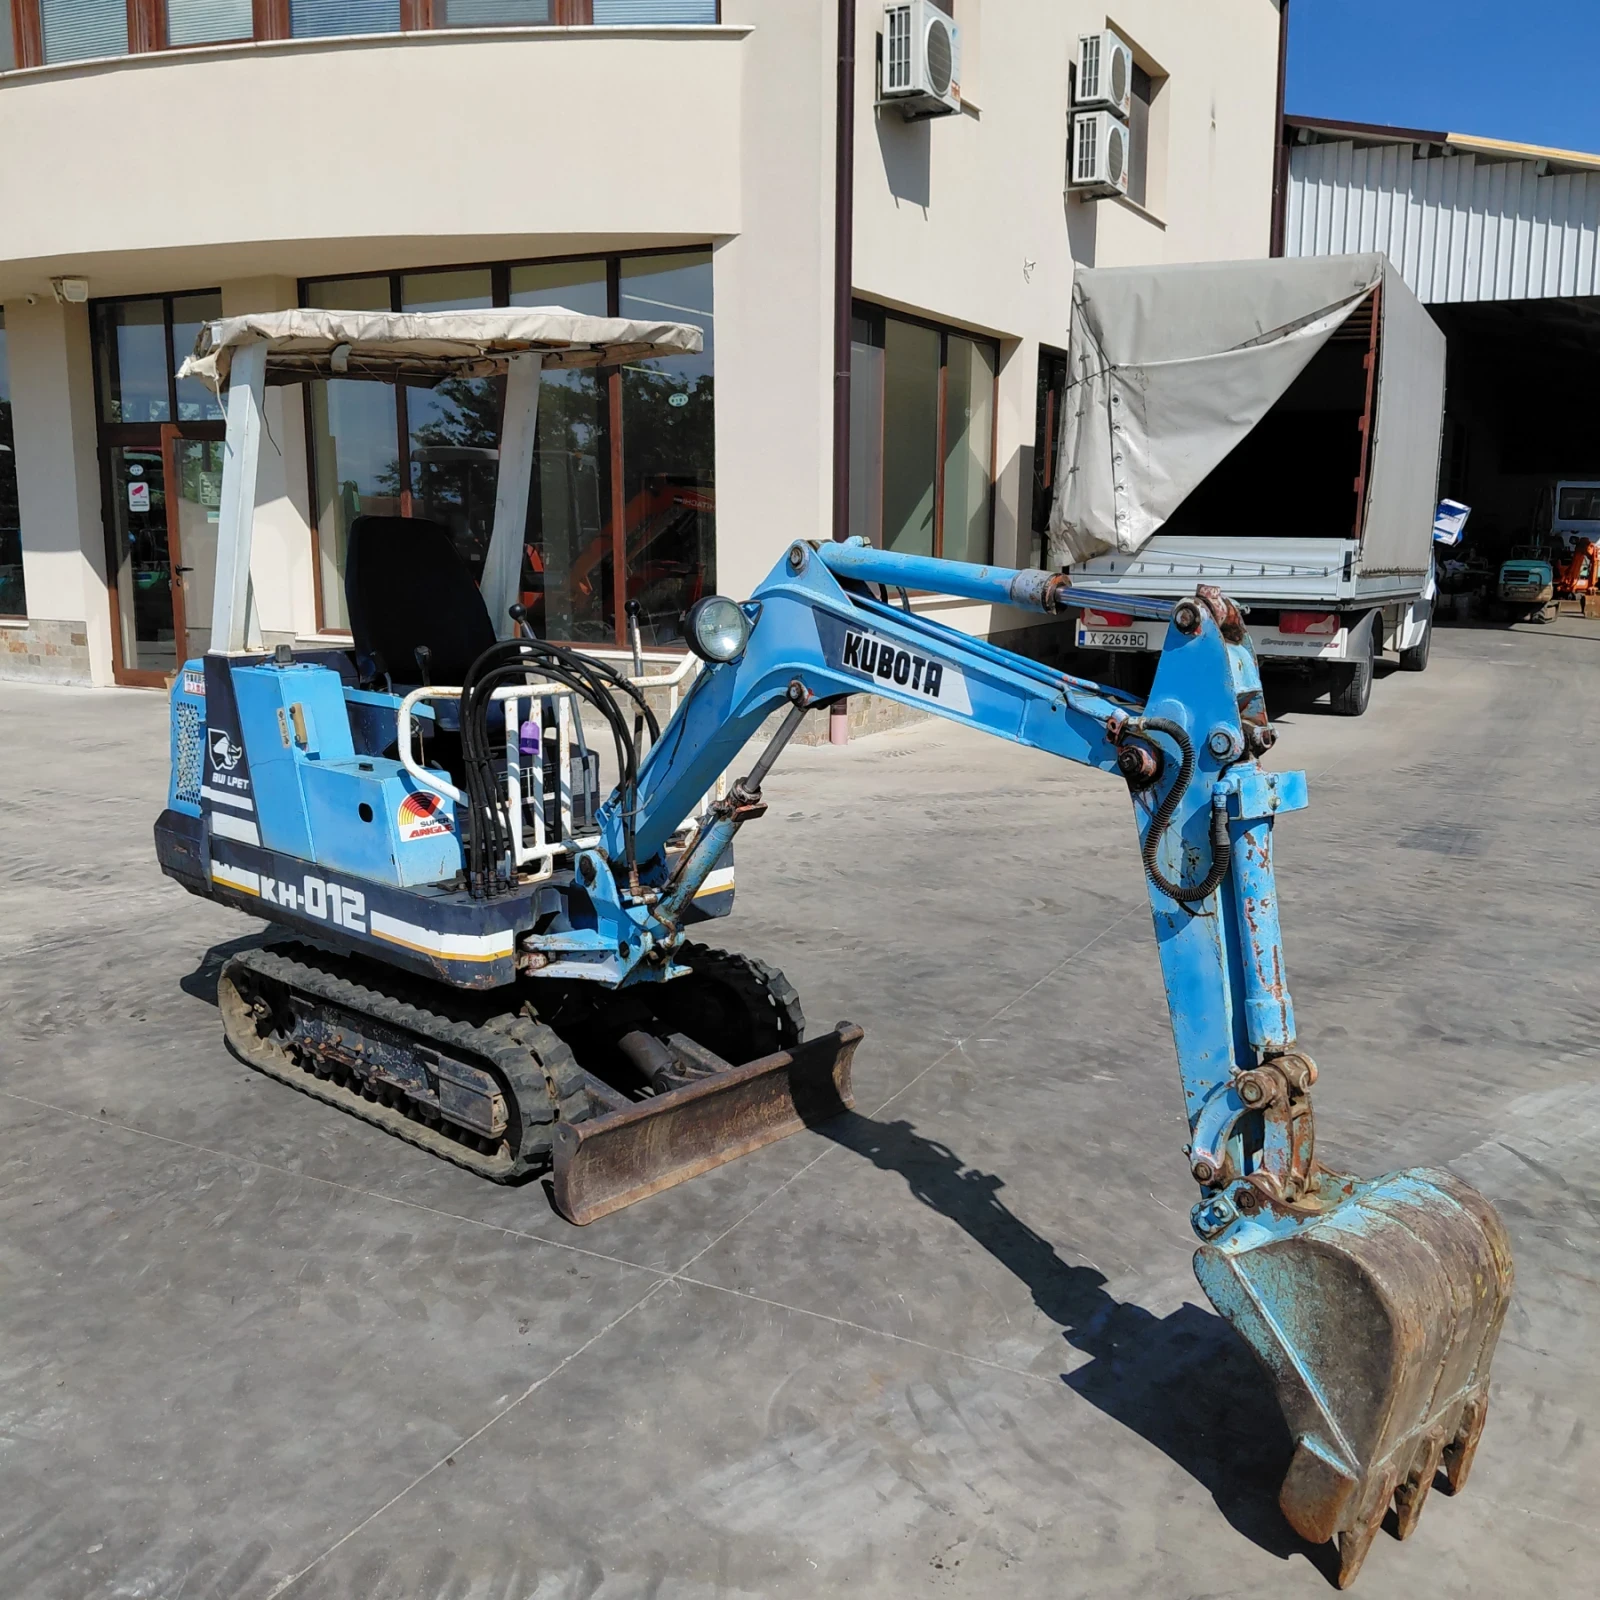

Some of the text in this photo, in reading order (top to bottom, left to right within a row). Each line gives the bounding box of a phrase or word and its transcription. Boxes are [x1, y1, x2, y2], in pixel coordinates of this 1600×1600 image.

[843, 632, 943, 697] KUBOTA
[409, 824, 454, 838] ANGLE
[420, 818, 449, 827] SUPER
[260, 875, 366, 933] KH-012
